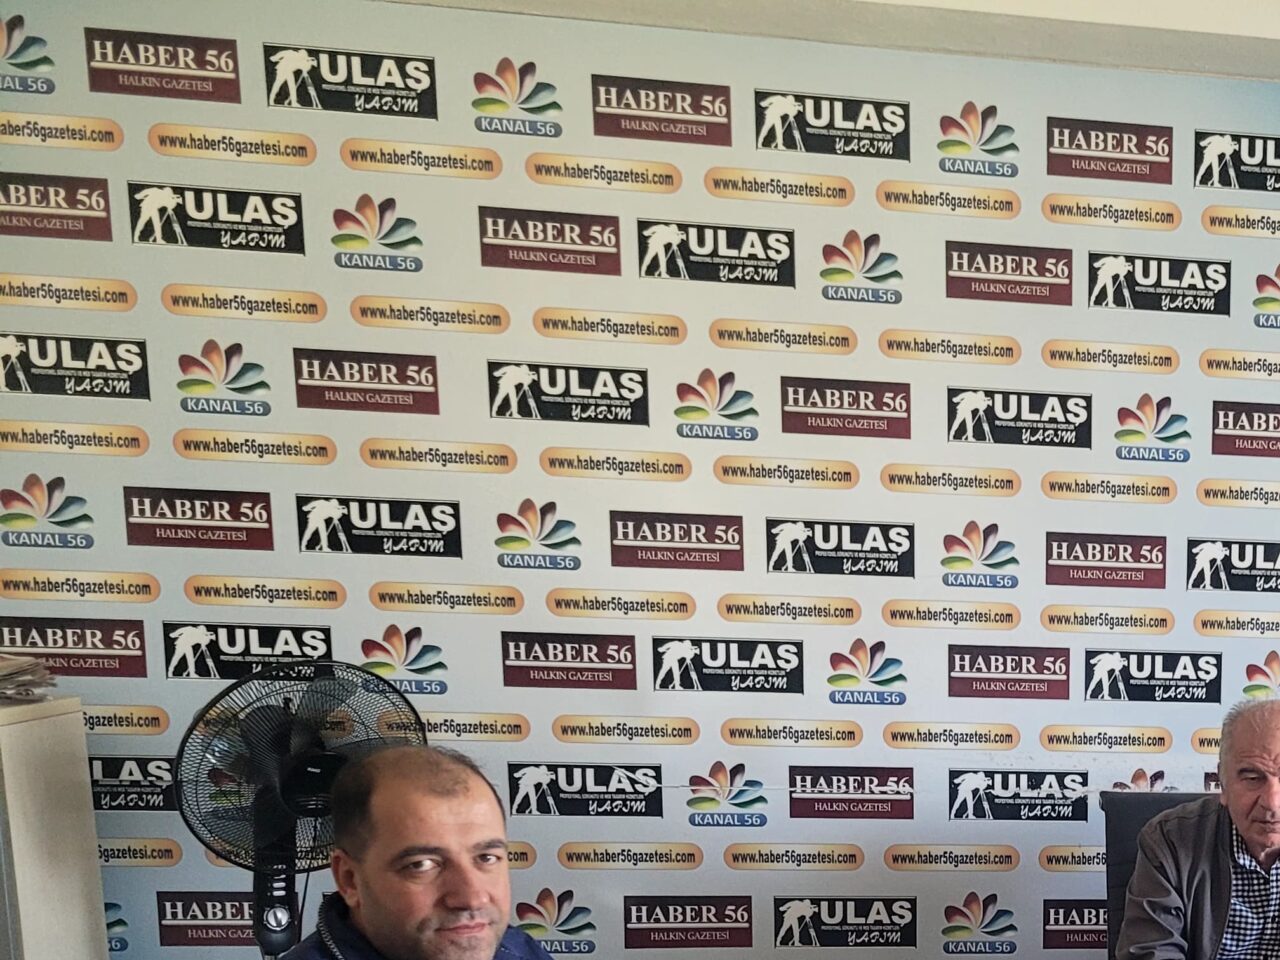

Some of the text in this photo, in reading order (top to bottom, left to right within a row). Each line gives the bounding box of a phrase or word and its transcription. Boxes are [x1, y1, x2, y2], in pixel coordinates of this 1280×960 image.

[91, 39, 235, 73] HABER 56
[320, 51, 432, 94] ULAŞ
[598, 86, 726, 117] HABER 56
[481, 118, 555, 136] KANAL 56
[804, 98, 905, 137] ULAŞ
[158, 134, 307, 157] www.haber56gazetesi.com
[1052, 128, 1169, 156] HABER 56
[349, 149, 493, 171] www.haber56gazetesi.com
[945, 159, 1012, 175] KANAL 56
[1072, 159, 1107, 170] HALKIN
[534, 163, 673, 186] www.haber56gazetesi.com
[712, 177, 846, 199] www.haber56gazetesi.com
[184, 188, 298, 230] ULAŞ
[885, 190, 1013, 212] www.haber56gazetesi.com
[1050, 203, 1174, 224] www.haber56gazetesi.com
[484, 217, 615, 246] HABER 56
[687, 227, 790, 264] ULAŞ
[341, 254, 415, 270] KANAL 56
[951, 251, 1068, 278] HABER 56
[1134, 258, 1227, 294] ULAŞ
[827, 286, 895, 303] KANAL 56
[970, 281, 1005, 292] HALKIN
[171, 293, 318, 315] www.haber56gazetesi.com
[359, 305, 501, 326] www.haber56gazetesi.com
[542, 317, 679, 337] www.haber56gazetesi.com
[718, 328, 849, 348] www.haber56gazetesi.com
[887, 338, 1013, 358] www.haber56gazetesi.com
[29, 336, 144, 375] ULAŞ
[1050, 348, 1172, 367] www.haber56gazetesi.com
[300, 359, 434, 386] HABER 56
[539, 367, 643, 403] ULAŞ
[188, 398, 263, 415] KANAL 56
[786, 386, 906, 412] HABER 56
[993, 394, 1088, 427] ULAŞ
[683, 424, 752, 439] KANAL 56
[807, 416, 842, 427] HALKIN
[183, 437, 328, 458] www.haber56gazetesi.com
[1235, 438, 1267, 449] HALKIN
[369, 447, 508, 467] www.haber56gazetesi.com
[1121, 447, 1184, 461] KANAL 56
[548, 456, 683, 475] www.haber56gazetesi.com
[722, 464, 851, 483] www.haber56gazetesi.com
[888, 472, 1013, 490] www.haber56gazetesi.com
[1049, 480, 1169, 498] www.haber56gazetesi.com
[130, 497, 268, 523] HABER 56
[349, 500, 456, 535] ULAŞ
[9, 532, 86, 547] KANAL 56
[616, 520, 739, 544] HABER 56
[813, 524, 910, 555] ULAŞ
[504, 554, 574, 569] KANAL 56
[1051, 542, 1162, 563] HABER 56
[947, 574, 1012, 588] KANAL 56
[1070, 569, 1102, 579] HALKIN
[2, 577, 151, 597] www.haber56gazetesi.com
[194, 584, 337, 603] www.haber56gazetesi.com
[378, 590, 515, 609] www.haber56gazetesi.com
[554, 596, 688, 615] www.haber56gazetesi.com
[726, 602, 853, 620] www.haber56gazetesi.com
[890, 607, 1013, 625] www.haber56gazetesi.com
[1048, 612, 1167, 630] www.haber56gazetesi.com
[3, 625, 142, 650] HABER 56
[218, 626, 328, 660] ULAŞ
[507, 641, 632, 663] HABER 56
[700, 642, 799, 672] ULAŞ
[954, 654, 1067, 674] HABER 56
[1128, 654, 1218, 683] ULAŞ
[973, 681, 1007, 690] HALKIN
[835, 691, 900, 704] KANAL 56
[561, 723, 691, 740] www.haber56gazetesi.com
[729, 726, 855, 743] www.haber56gazetesi.com
[891, 729, 1012, 746] www.haber56gazetesi.com
[1047, 732, 1165, 749] www.haber56gazetesi.com
[558, 766, 658, 796] ULAŞ
[794, 775, 910, 794] HABER 56
[994, 773, 1084, 801] ULAŞ
[814, 802, 849, 810] HALKIN
[695, 814, 760, 826] KANAL 56
[566, 849, 695, 866] www.haber56gazetesi.com
[732, 850, 856, 866] www.haber56gazetesi.com
[892, 851, 1012, 867] www.haber56gazetesi.com
[629, 904, 749, 923] HABER 56
[821, 900, 914, 927] ULAŞ
[650, 932, 685, 940] HALKIN
[948, 941, 1011, 953] KANAL 56
